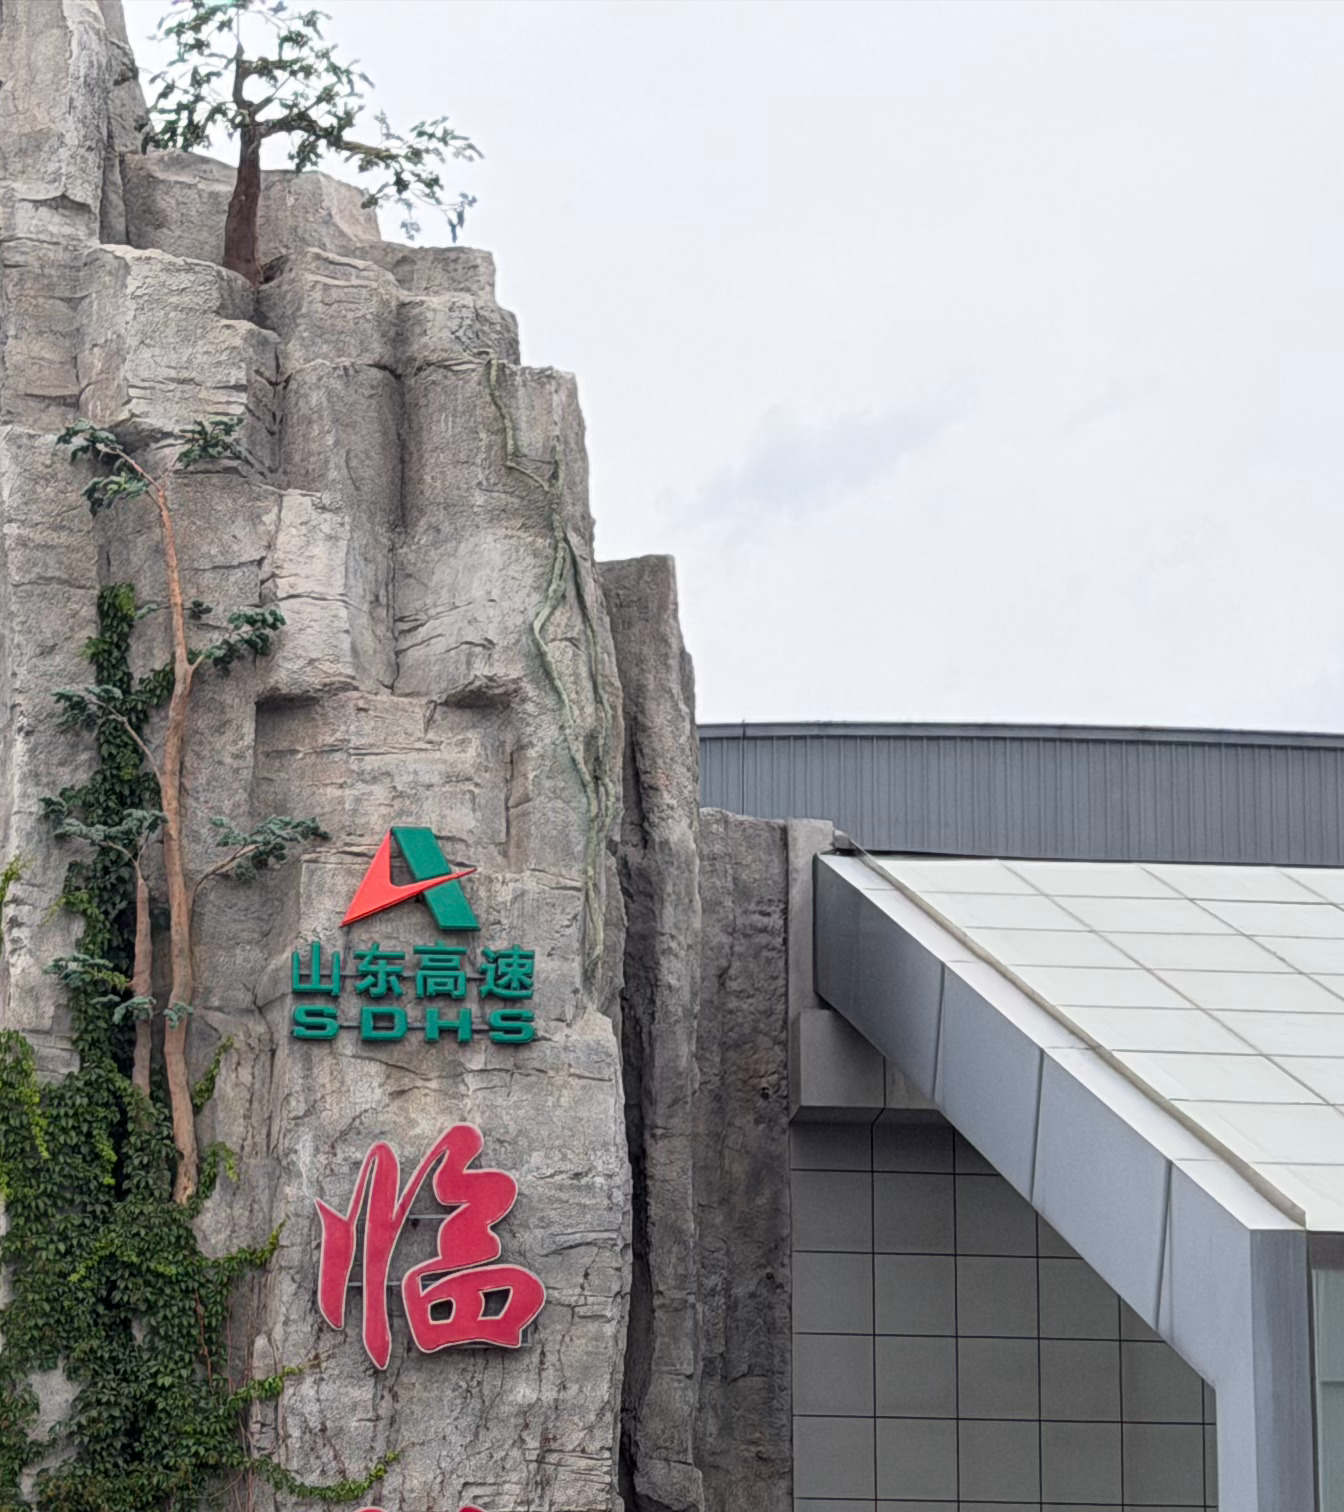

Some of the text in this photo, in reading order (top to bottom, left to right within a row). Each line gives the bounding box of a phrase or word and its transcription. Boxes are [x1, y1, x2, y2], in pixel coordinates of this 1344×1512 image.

[291, 940, 535, 999] 山东高速
[291, 1004, 536, 1044] SDHS
